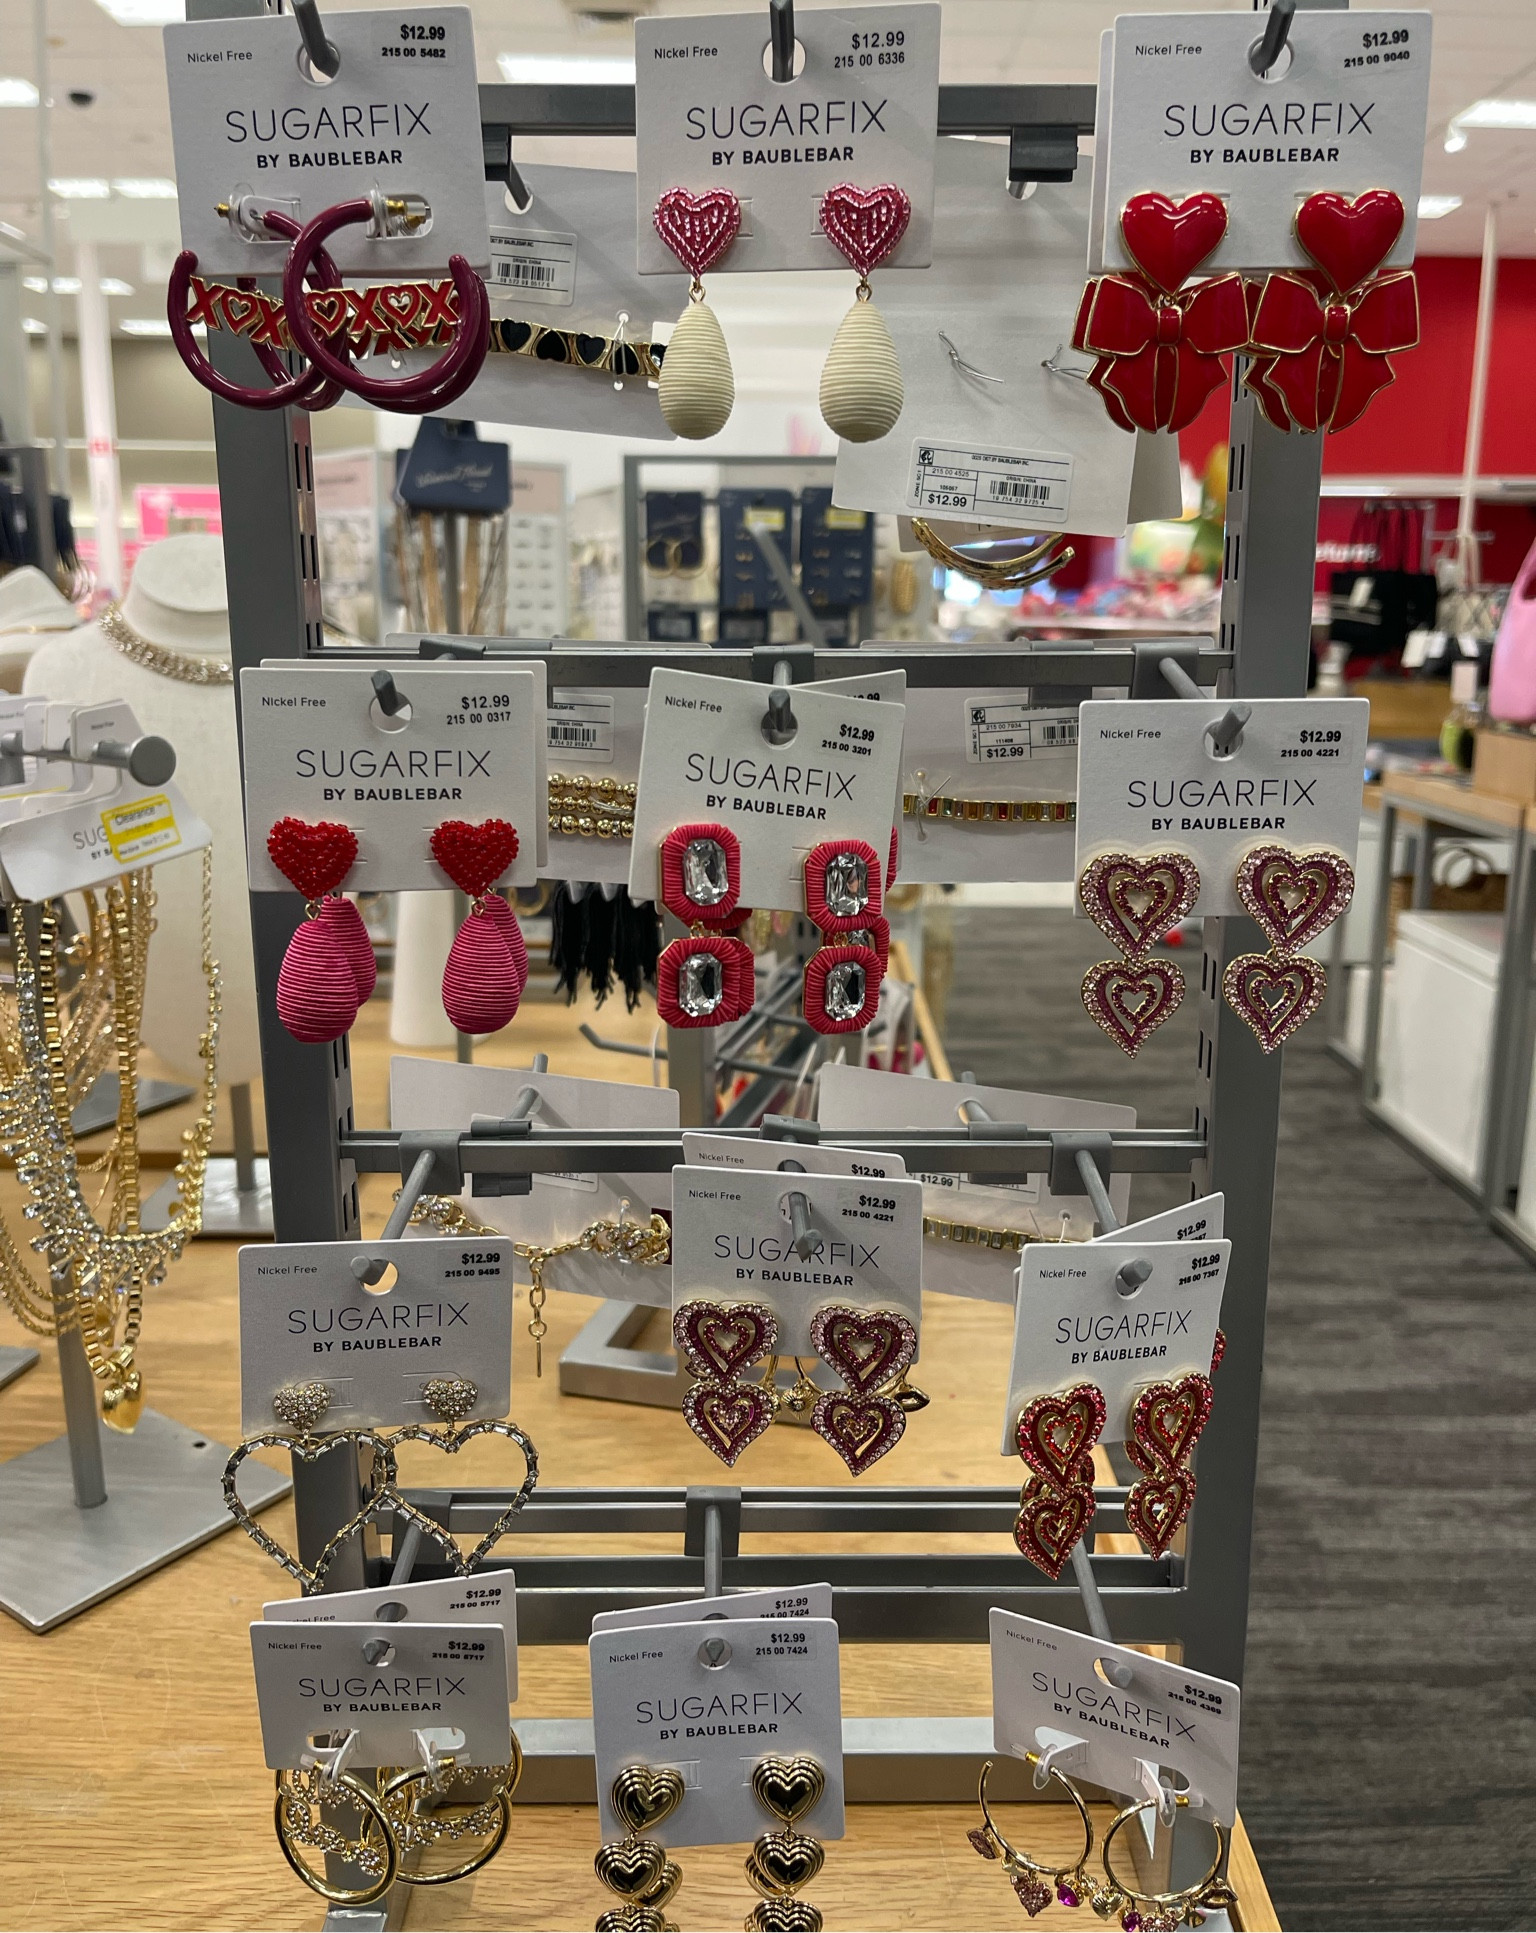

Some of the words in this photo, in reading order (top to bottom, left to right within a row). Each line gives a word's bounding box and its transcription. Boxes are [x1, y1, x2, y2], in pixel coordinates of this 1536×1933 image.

[401, 25, 445, 41] $12.99
[852, 31, 905, 50] $12.99
[1363, 30, 1409, 49] $12.99
[187, 51, 223, 63] Nickel
[226, 50, 253, 62] Free
[381, 46, 401, 58] 215
[402, 46, 417, 57] 00
[420, 47, 446, 59] 5482
[654, 47, 689, 59] Nickel
[693, 46, 718, 57] Free
[1135, 43, 1172, 56] Nickel
[1175, 43, 1202, 56] Free
[834, 55, 854, 68] 215
[860, 53, 872, 66] 00
[878, 52, 905, 66] 6336
[1344, 57, 1364, 68] 215
[1366, 55, 1380, 65] 00
[1383, 51, 1410, 63] 9040
[226, 102, 432, 143] SUGARFIX
[686, 99, 888, 140] SUGARFIX
[1164, 103, 1376, 137] SUGARFIX
[257, 154, 279, 169] BY
[289, 149, 403, 168] BAUBLEBAR
[712, 151, 734, 165] BY
[743, 147, 854, 164] BAUBLEBAR
[1191, 149, 1214, 164] BY
[1223, 147, 1339, 163] BAUBLEBAR
[928, 494, 967, 507] $12.99
[262, 697, 297, 707] Nickel
[301, 698, 326, 707] Free
[462, 695, 510, 710] $12.99
[665, 696, 697, 709] Nickel
[700, 700, 722, 713] Free
[447, 715, 465, 725] 215
[470, 713, 483, 723] 00
[488, 712, 511, 722] 0317
[839, 724, 875, 742] $12.99
[1100, 730, 1134, 739] Nickel
[1137, 729, 1161, 739] Free
[1300, 730, 1342, 743] $12.99
[822, 740, 838, 750] 215
[839, 742, 849, 752] 00
[852, 745, 871, 756] 3201
[987, 747, 1023, 758] $12.99
[1280, 749, 1299, 758] 215
[1301, 749, 1313, 757] 00
[1316, 748, 1339, 757] 4221
[296, 749, 491, 777] SUGARFIX
[685, 753, 856, 800] SUGARFIX
[324, 789, 345, 800] BY
[355, 788, 462, 800] BAUBLEBAR
[1127, 779, 1317, 808] SUGARFIX
[706, 795, 726, 808] BY
[733, 798, 826, 820] BAUBLEBAR
[1152, 819, 1173, 830] BY
[1181, 817, 1285, 830] BAUBLEBAR
[699, 1153, 724, 1162] Nickel
[726, 1155, 744, 1164] Free
[851, 1164, 885, 1178] $12.99
[920, 1174, 953, 1187] $12.99
[689, 1190, 718, 1199] Nickel
[720, 1191, 741, 1201] Free
[859, 1195, 896, 1210] $12.99
[842, 1209, 858, 1217] 215
[859, 1211, 870, 1219] 00
[873, 1213, 894, 1222] 4221
[1177, 1220, 1206, 1240] $12.99
[714, 1234, 880, 1268] SUGARFIX
[462, 1253, 500, 1265] $12.99
[1192, 1253, 1220, 1270] $12.99
[258, 1267, 290, 1276] Nickel
[294, 1265, 317, 1274] Free
[445, 1270, 462, 1278] 215
[464, 1269, 475, 1277] 00
[478, 1268, 500, 1276] 9495
[736, 1268, 755, 1279] BY
[762, 1270, 853, 1286] BAUBLEBAR
[1040, 1270, 1066, 1279] Nickel
[1068, 1269, 1087, 1278] Free
[1179, 1276, 1191, 1286] 215
[1192, 1273, 1201, 1282] 00
[288, 1302, 470, 1334] SUGARFIX
[1056, 1309, 1192, 1344] SUGARFIX
[313, 1342, 334, 1353] BY
[342, 1336, 442, 1351] BAUBLEBAR
[1072, 1353, 1088, 1364] BY
[1093, 1345, 1167, 1362] BAUBLEBAR
[466, 1588, 501, 1599] $12.99
[776, 1597, 808, 1609] $12.99
[790, 1608, 809, 1617] 7424
[771, 1633, 806, 1644] $12.99
[1006, 1630, 1034, 1643] Nickel
[1037, 1639, 1057, 1651] Free
[268, 1642, 298, 1650] Nickel
[301, 1643, 322, 1651] Free
[448, 1641, 485, 1652] $12.99
[432, 1652, 448, 1660] 215
[610, 1652, 639, 1663] Nickel
[642, 1650, 663, 1660] Free
[299, 1677, 466, 1697] SUGARFIX
[1168, 1692, 1185, 1701] 215
[1186, 1697, 1197, 1706] 00
[1185, 1685, 1222, 1705] $12.99
[324, 1704, 341, 1712] BY
[350, 1703, 441, 1712] BAUBLEBAR
[636, 1692, 803, 1724] SUGARFIX
[1032, 1672, 1196, 1742] SUGARFIX
[660, 1729, 678, 1740] BY
[686, 1723, 778, 1738] BAUBLEBAR
[1054, 1703, 1072, 1717] BY
[1079, 1711, 1170, 1749] BAUBLEBAR
